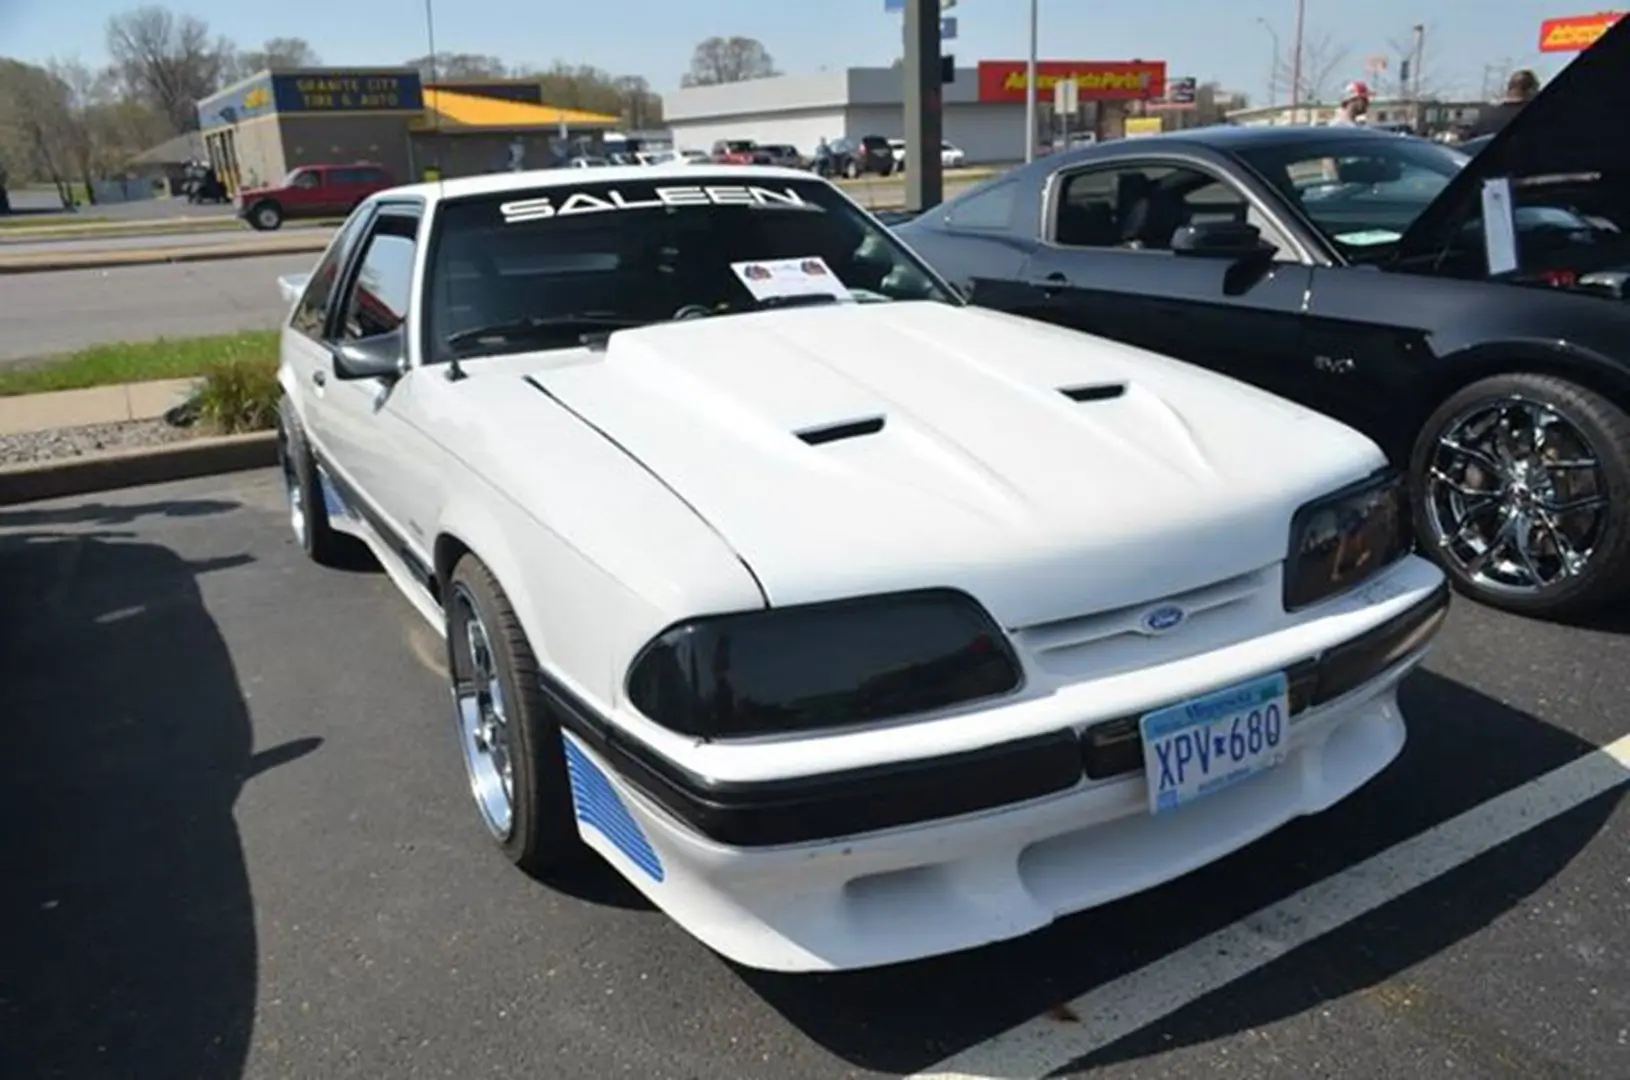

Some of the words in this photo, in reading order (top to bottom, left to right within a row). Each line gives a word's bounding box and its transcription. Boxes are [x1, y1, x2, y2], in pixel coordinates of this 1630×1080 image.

[367, 78, 399, 91] CITY
[303, 93, 333, 107] TIRE
[341, 93, 353, 107] &
[361, 93, 399, 107] AUTO
[500, 186, 806, 223] SALEEN
